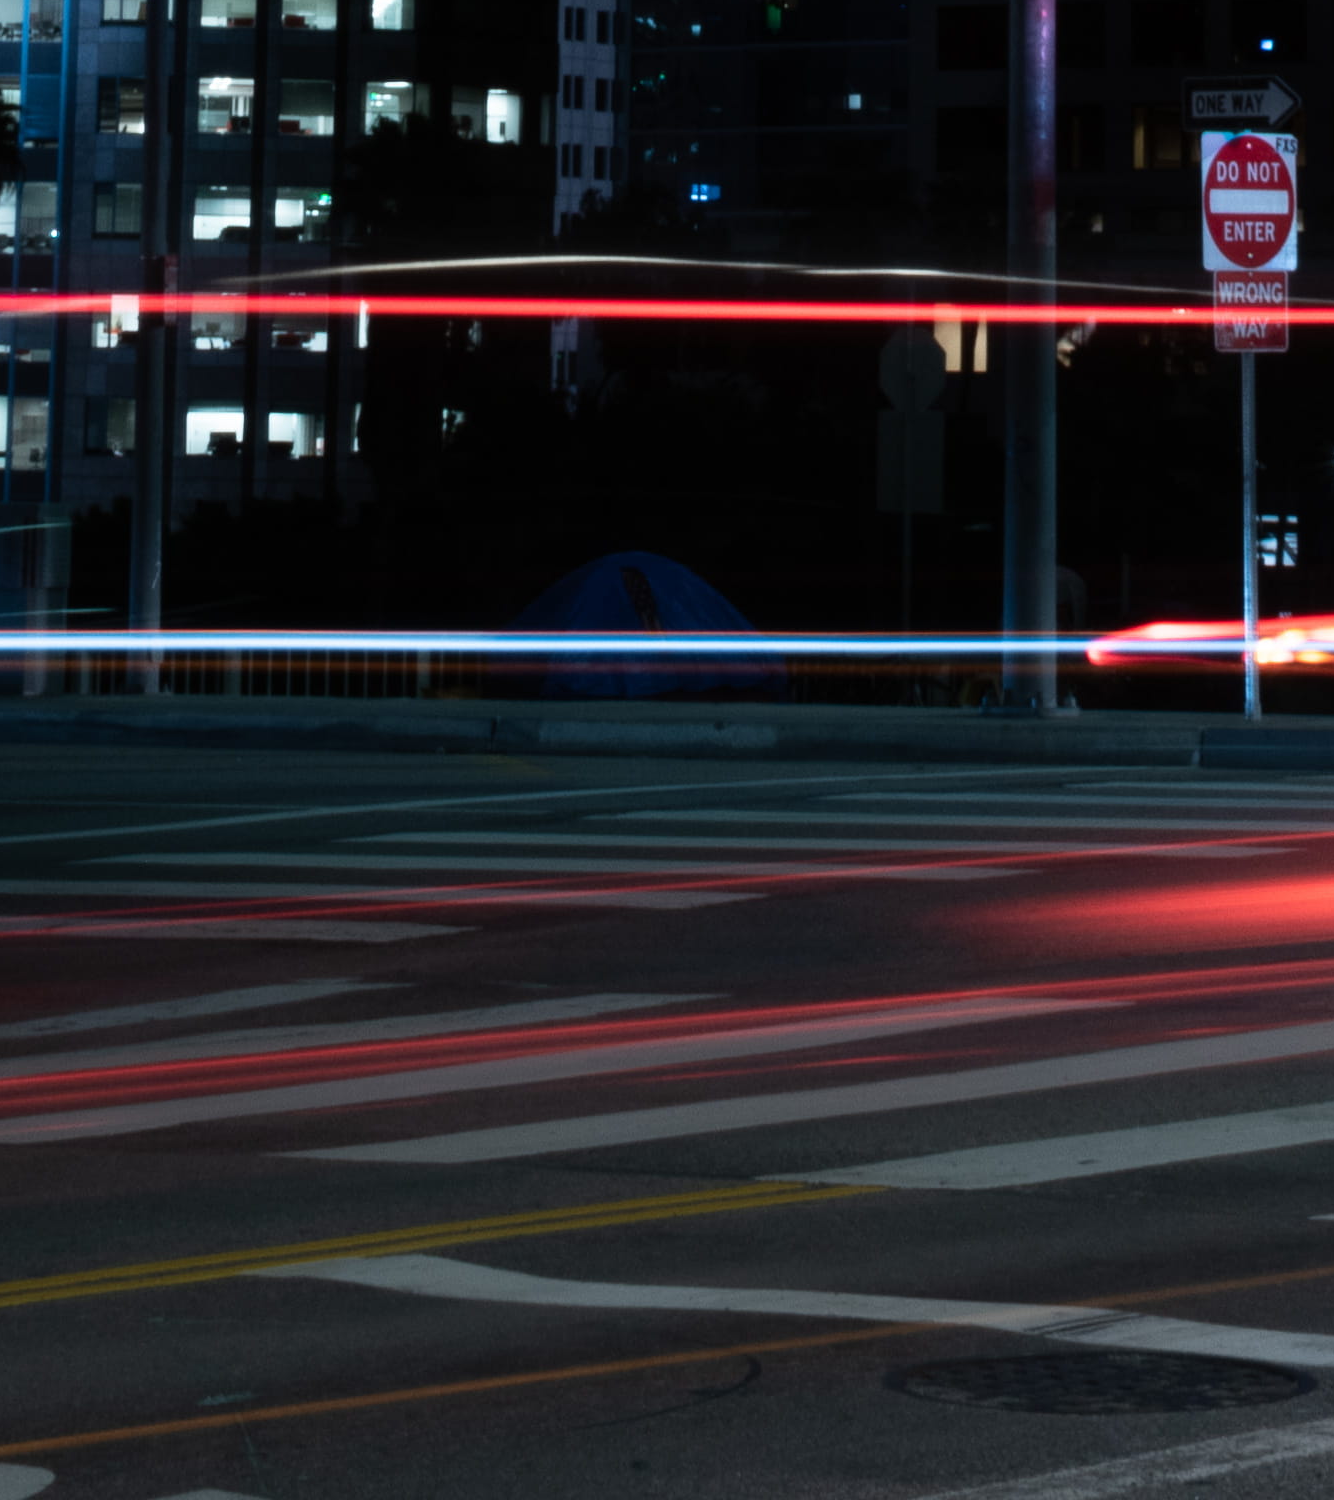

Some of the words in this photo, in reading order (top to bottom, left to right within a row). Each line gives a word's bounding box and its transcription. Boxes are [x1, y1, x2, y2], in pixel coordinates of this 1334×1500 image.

[1195, 94, 1226, 114] ONE
[1231, 93, 1265, 113] WAY
[1216, 160, 1240, 183] DO
[1247, 161, 1281, 183] NOT
[1223, 220, 1276, 242] ENTER
[1218, 281, 1284, 304] WRONG
[1232, 315, 1270, 339] WAY
